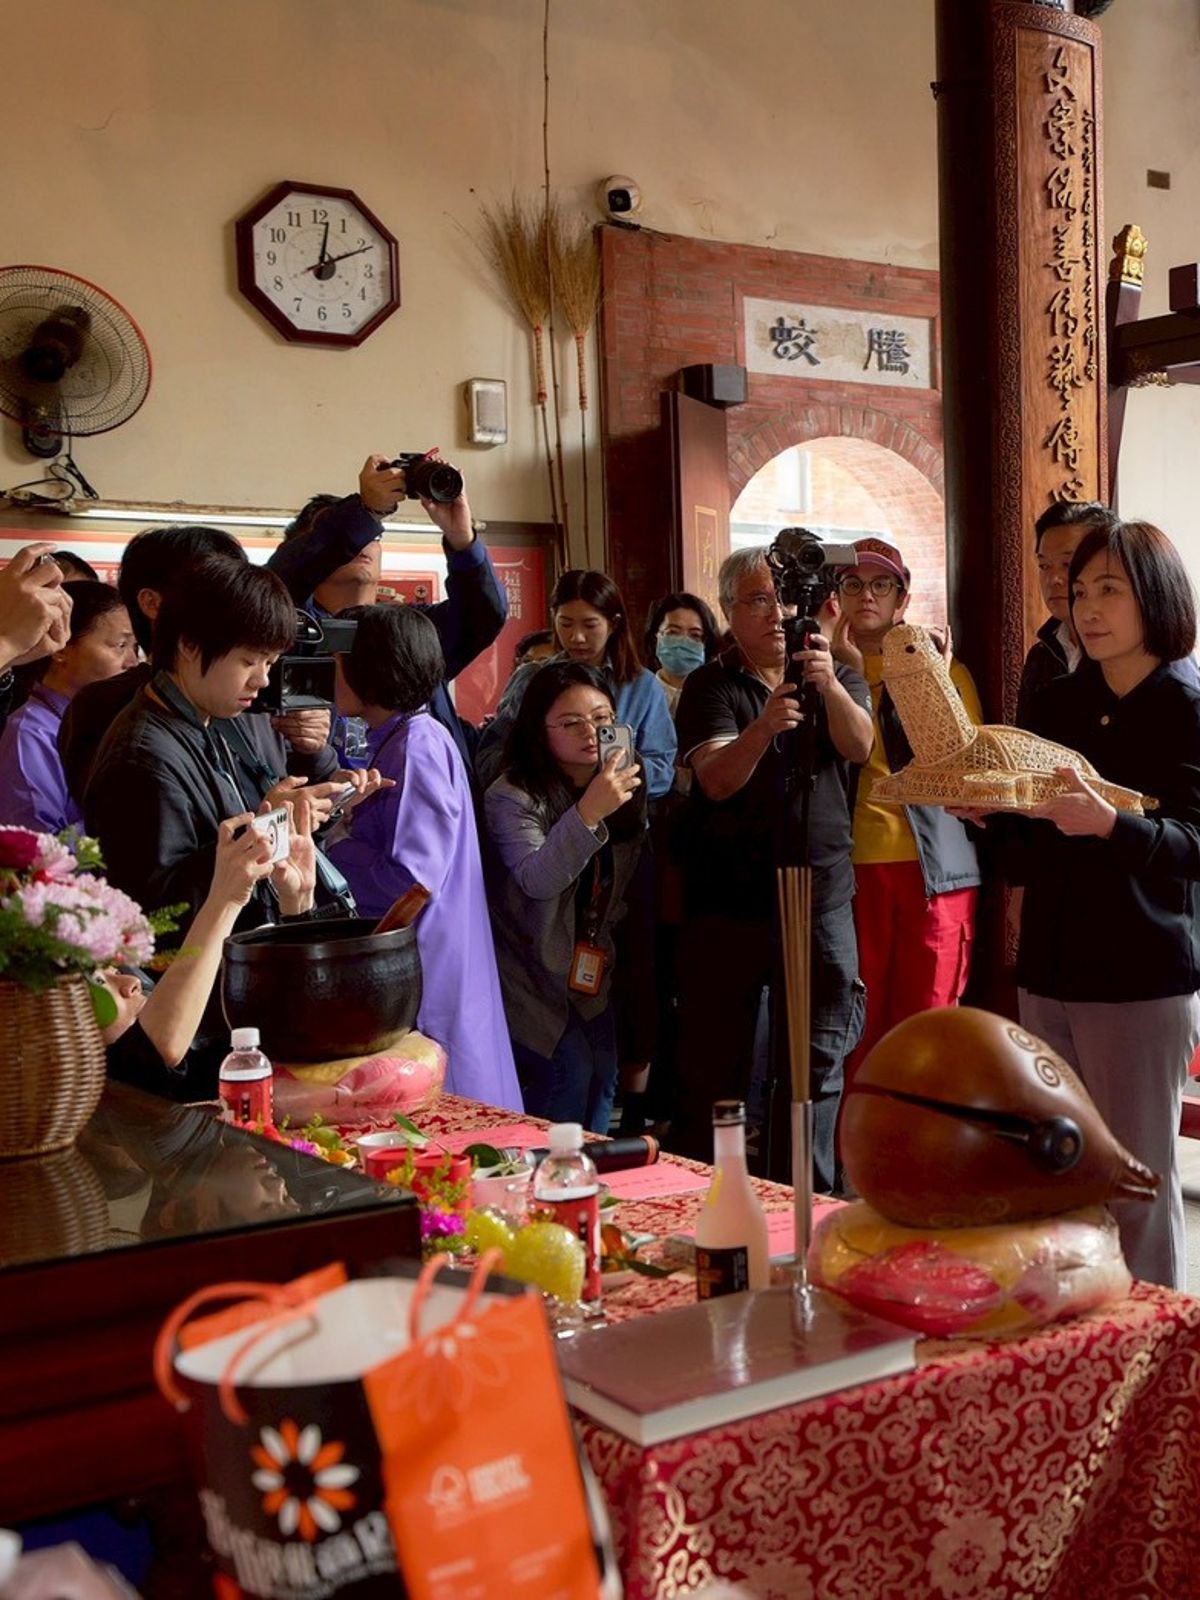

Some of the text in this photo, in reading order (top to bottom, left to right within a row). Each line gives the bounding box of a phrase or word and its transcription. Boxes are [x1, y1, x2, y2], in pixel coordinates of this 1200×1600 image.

[287, 211, 302, 228] 11
[311, 209, 329, 225] 12
[340, 218, 347, 233] 1
[270, 227, 286, 243] 10
[266, 252, 277, 265] 9
[363, 264, 373, 279] 3
[273, 276, 284, 291] 8
[358, 286, 367, 301] 4
[293, 297, 303, 313] 7
[342, 302, 352, 318] 5
[317, 306, 328, 321] 6
